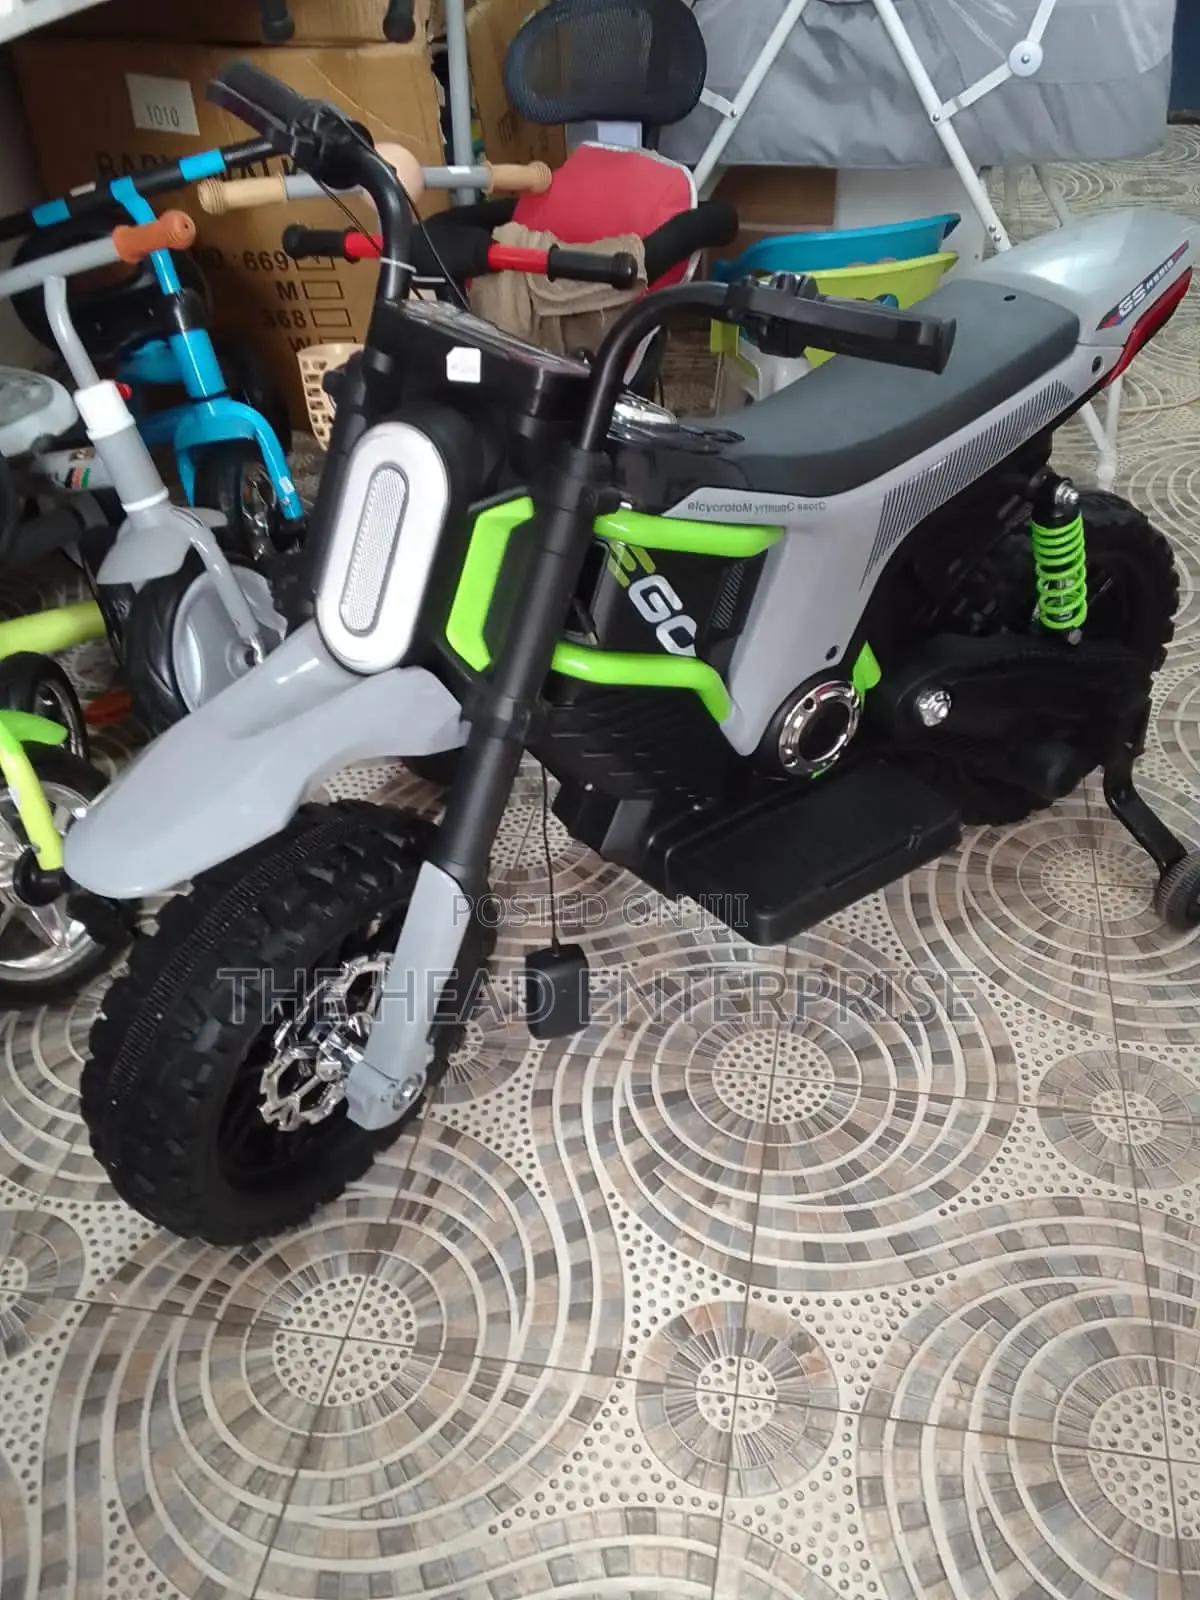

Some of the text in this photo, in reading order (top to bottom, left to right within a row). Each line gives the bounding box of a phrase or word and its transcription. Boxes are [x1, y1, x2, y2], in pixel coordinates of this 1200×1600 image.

[146, 104, 180, 128] 1010
[276, 280, 299, 301] M
[1119, 283, 1147, 317] GS
